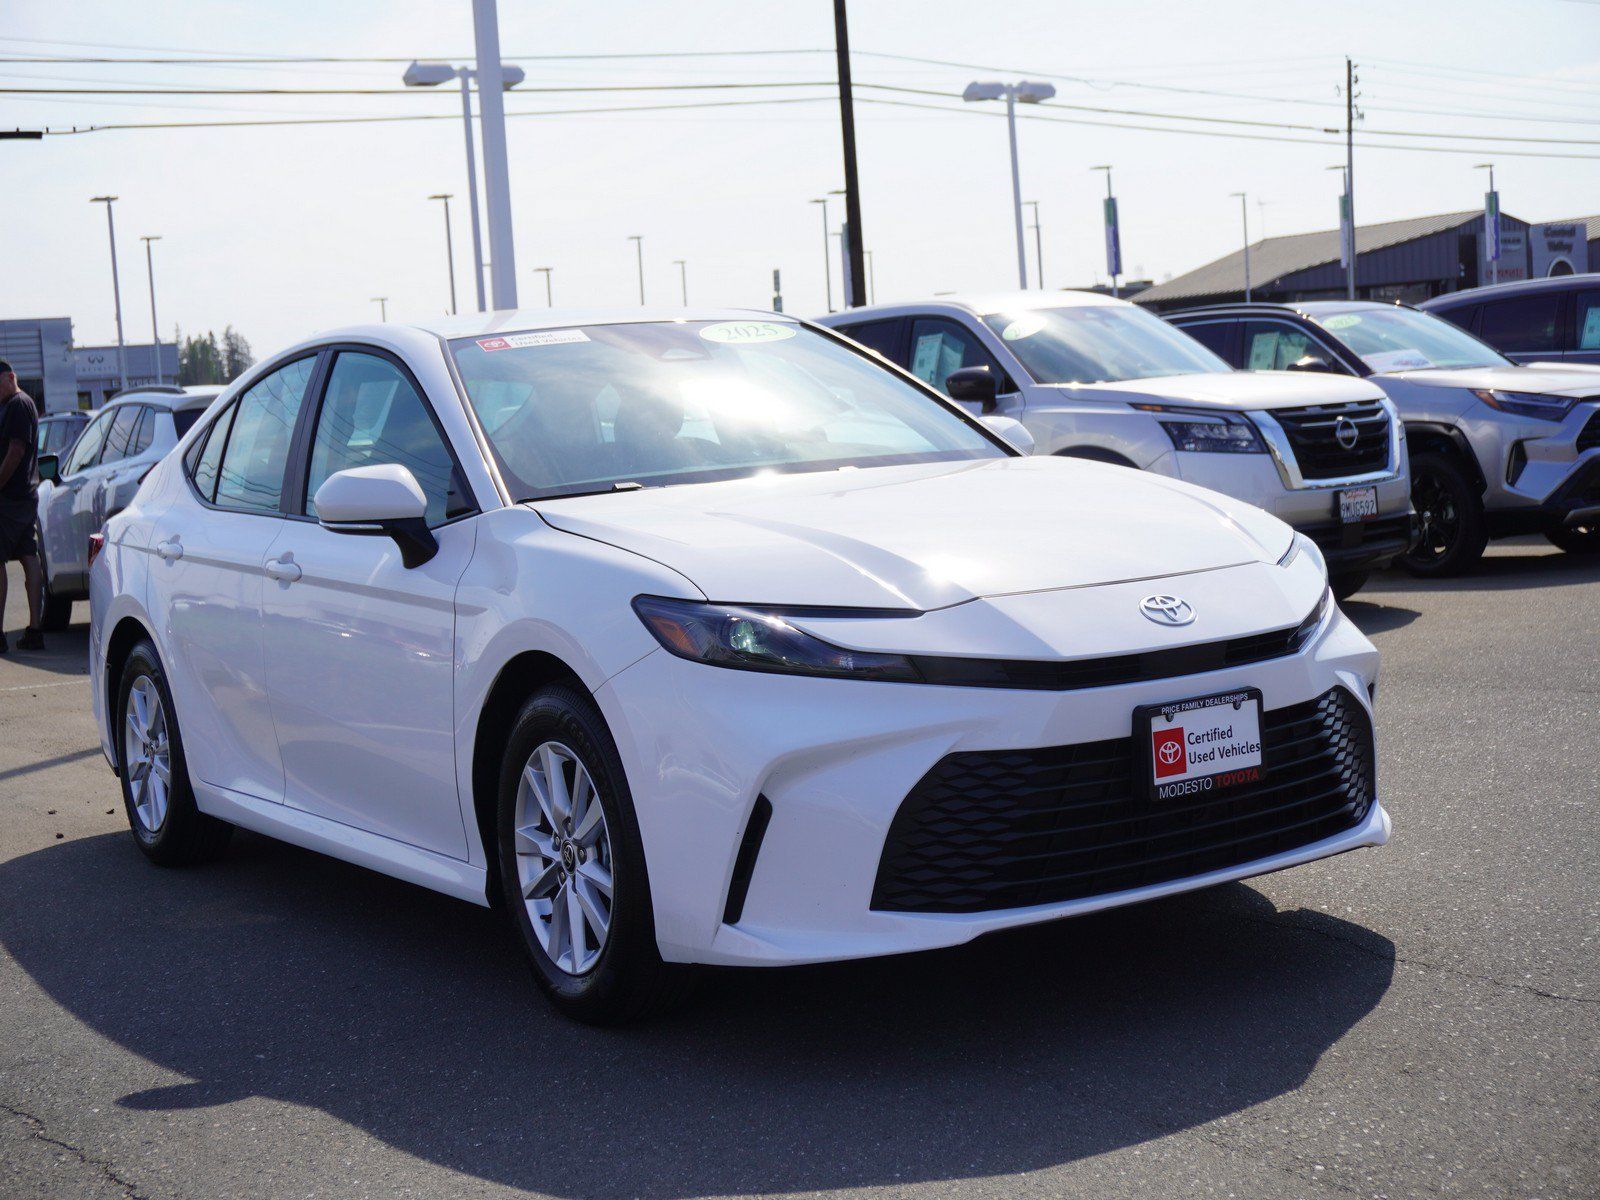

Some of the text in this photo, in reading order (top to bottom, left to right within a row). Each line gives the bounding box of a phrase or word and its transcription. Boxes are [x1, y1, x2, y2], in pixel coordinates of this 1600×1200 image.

[718, 324, 778, 340] 2025
[1161, 693, 1249, 715] PRICE FAMILY DEALERSHIPS
[1187, 725, 1233, 745] Certified
[1188, 741, 1261, 764] Used Vehicles
[1159, 768, 1259, 799] MODESTO TOYOTA
